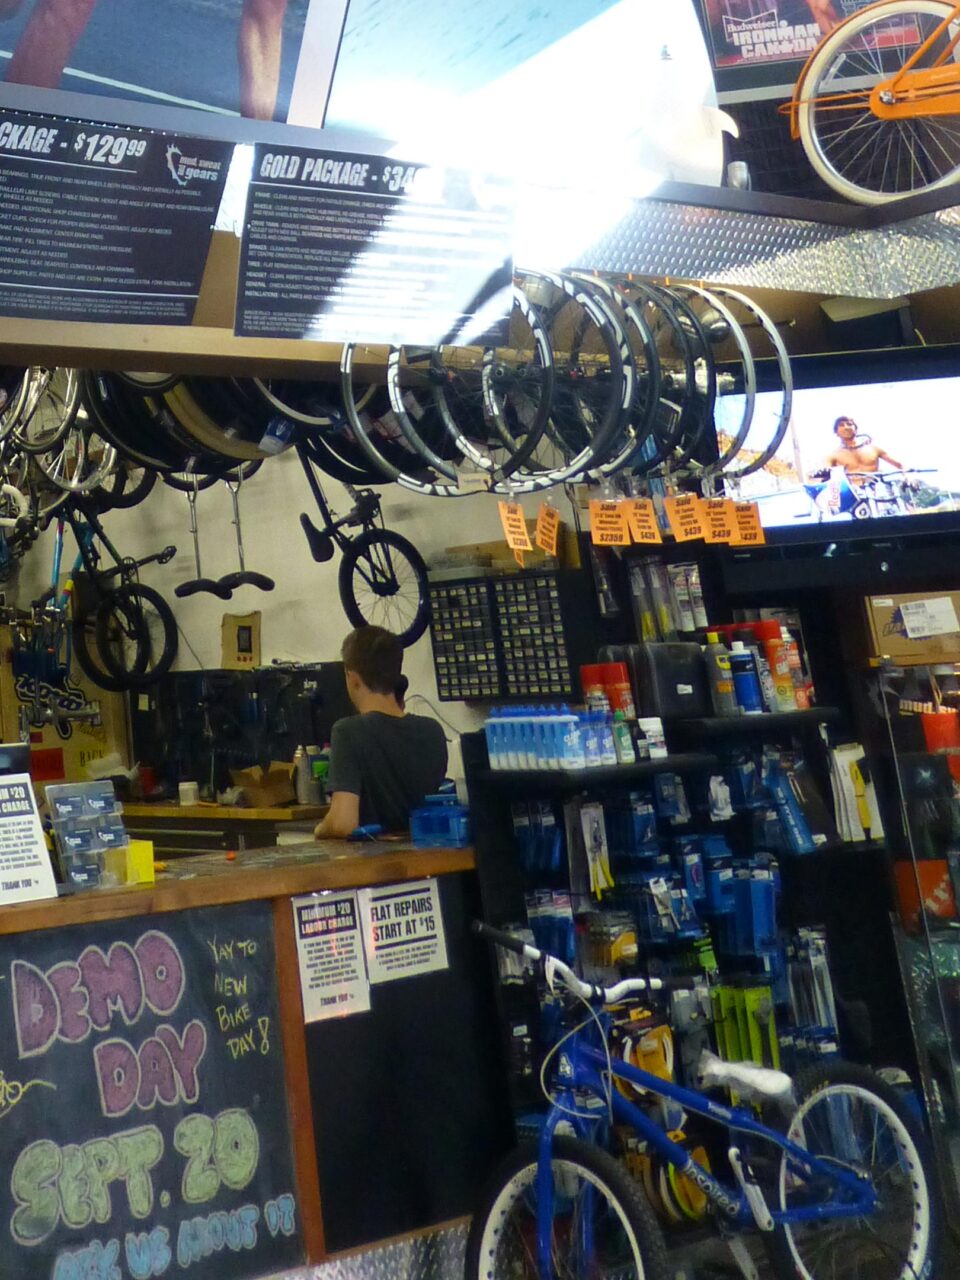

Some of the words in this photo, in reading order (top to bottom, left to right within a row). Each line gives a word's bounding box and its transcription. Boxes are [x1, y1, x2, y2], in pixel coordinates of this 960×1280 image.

[732, 23, 820, 46] IRONMAN
[741, 37, 818, 58] CANADA
[260, 153, 300, 178] GOLD
[301, 158, 370, 186] PACKAGE
[10, 787, 26, 799] $20
[2, 800, 31, 813] CHARGE
[1, 880, 20, 891] THANK
[21, 878, 33, 888] YOU
[370, 904, 391, 923] FLAT
[394, 897, 433, 918] REPAIRS
[372, 922, 402, 942] START
[405, 919, 416, 933] AT
[420, 915, 435, 931] $15
[207, 933, 234, 964] YAY
[237, 939, 257, 957] TO
[11, 930, 185, 1060] DEMO
[215, 972, 248, 997] NEW
[216, 1002, 252, 1032] BIKE
[94, 1020, 207, 1117] DAY
[174, 1108, 260, 1203] 20
